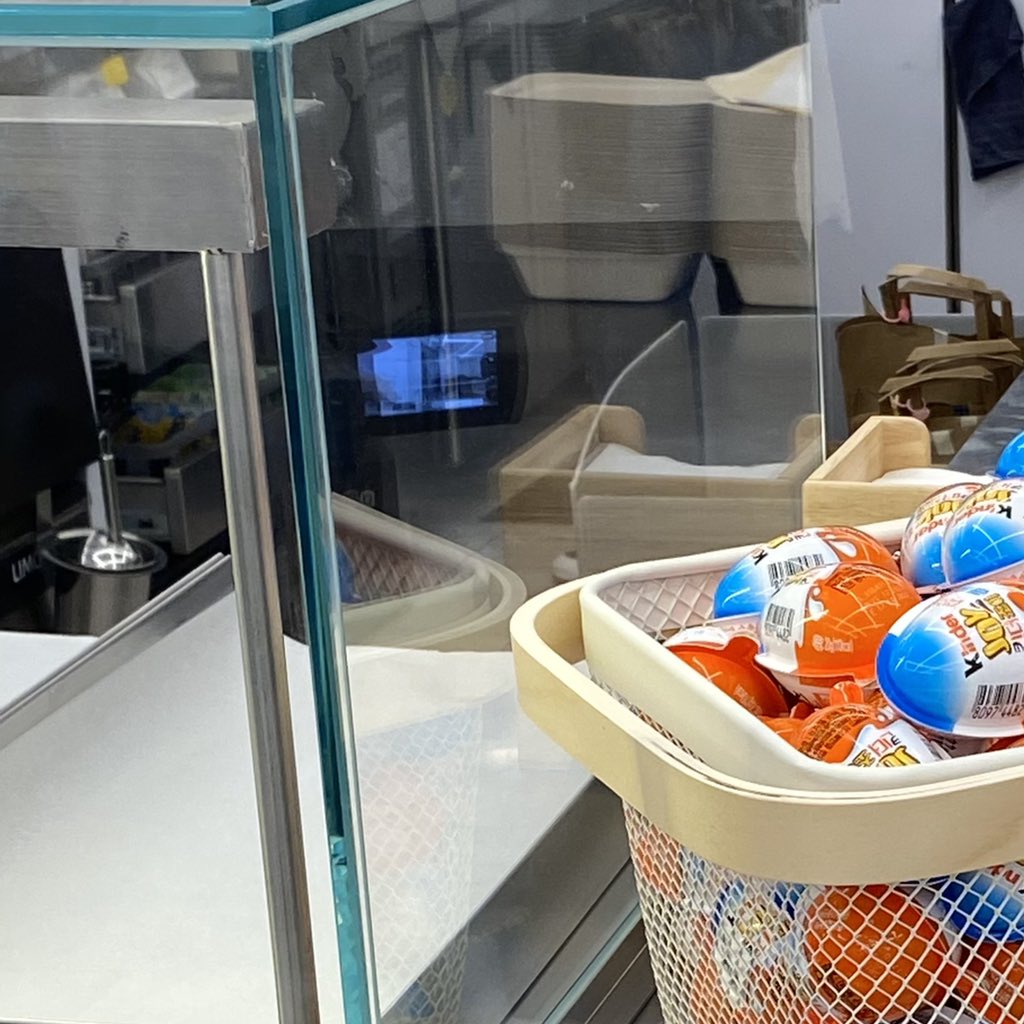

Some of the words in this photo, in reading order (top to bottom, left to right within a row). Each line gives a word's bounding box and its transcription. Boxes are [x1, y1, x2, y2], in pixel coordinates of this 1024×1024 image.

[940, 613, 983, 678] Kinder
[959, 608, 1012, 660] JOY
[971, 706, 997, 720] 8097
[1001, 704, 1023, 718] 4482
[849, 731, 901, 767] 킨더조
